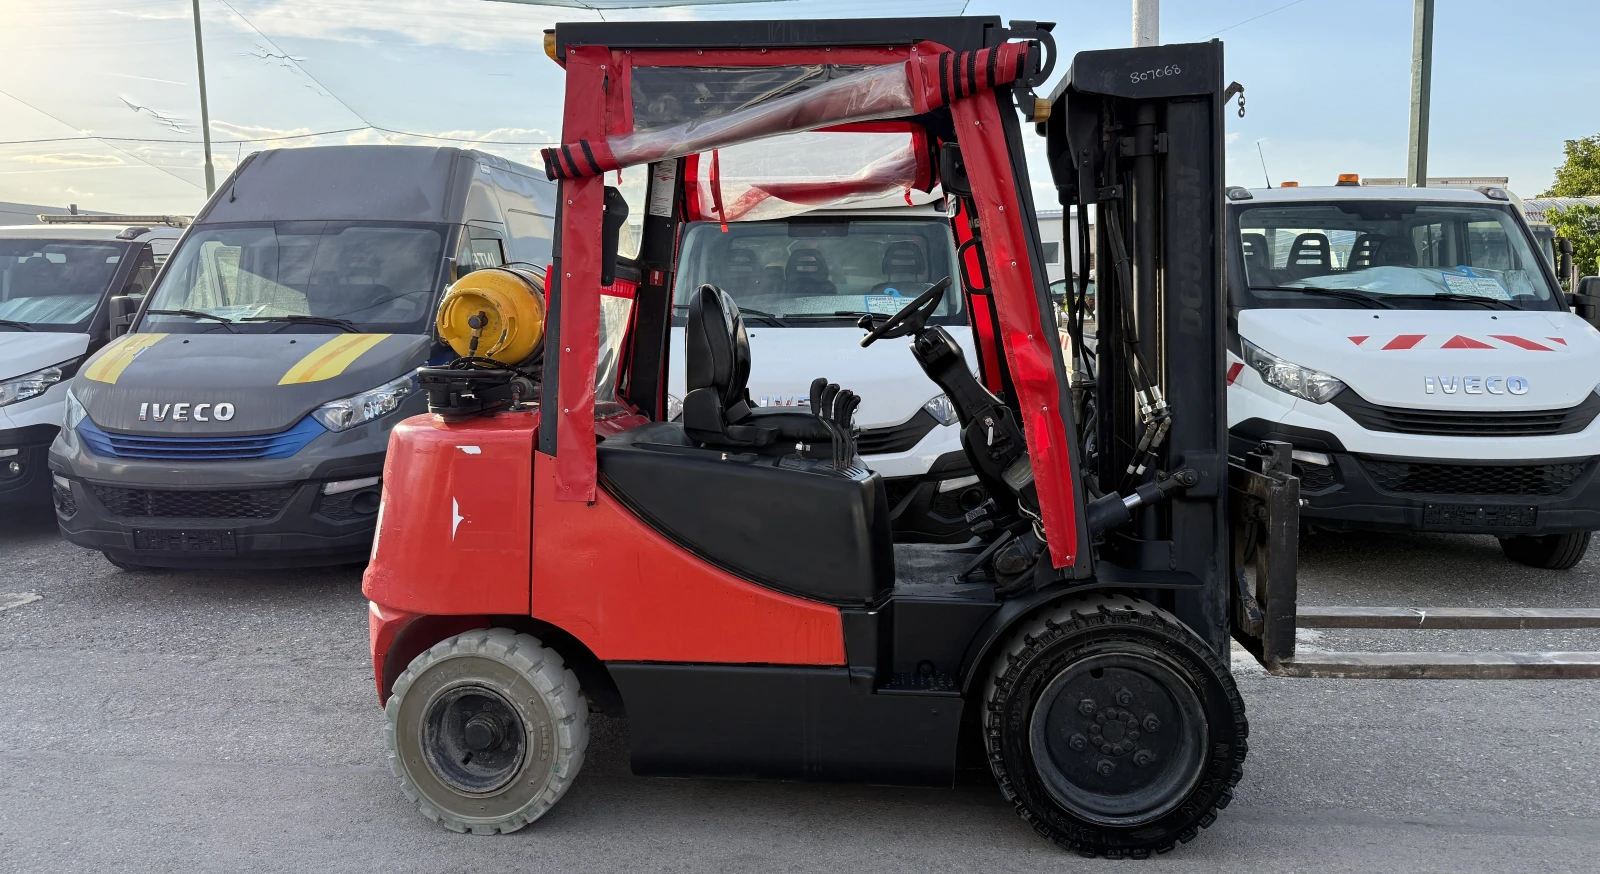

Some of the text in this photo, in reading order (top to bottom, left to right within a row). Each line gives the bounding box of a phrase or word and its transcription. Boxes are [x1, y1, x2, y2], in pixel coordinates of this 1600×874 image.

[1130, 64, 1181, 84] 807068
[1424, 376, 1529, 395] IVECO
[139, 402, 235, 421] IVECO
